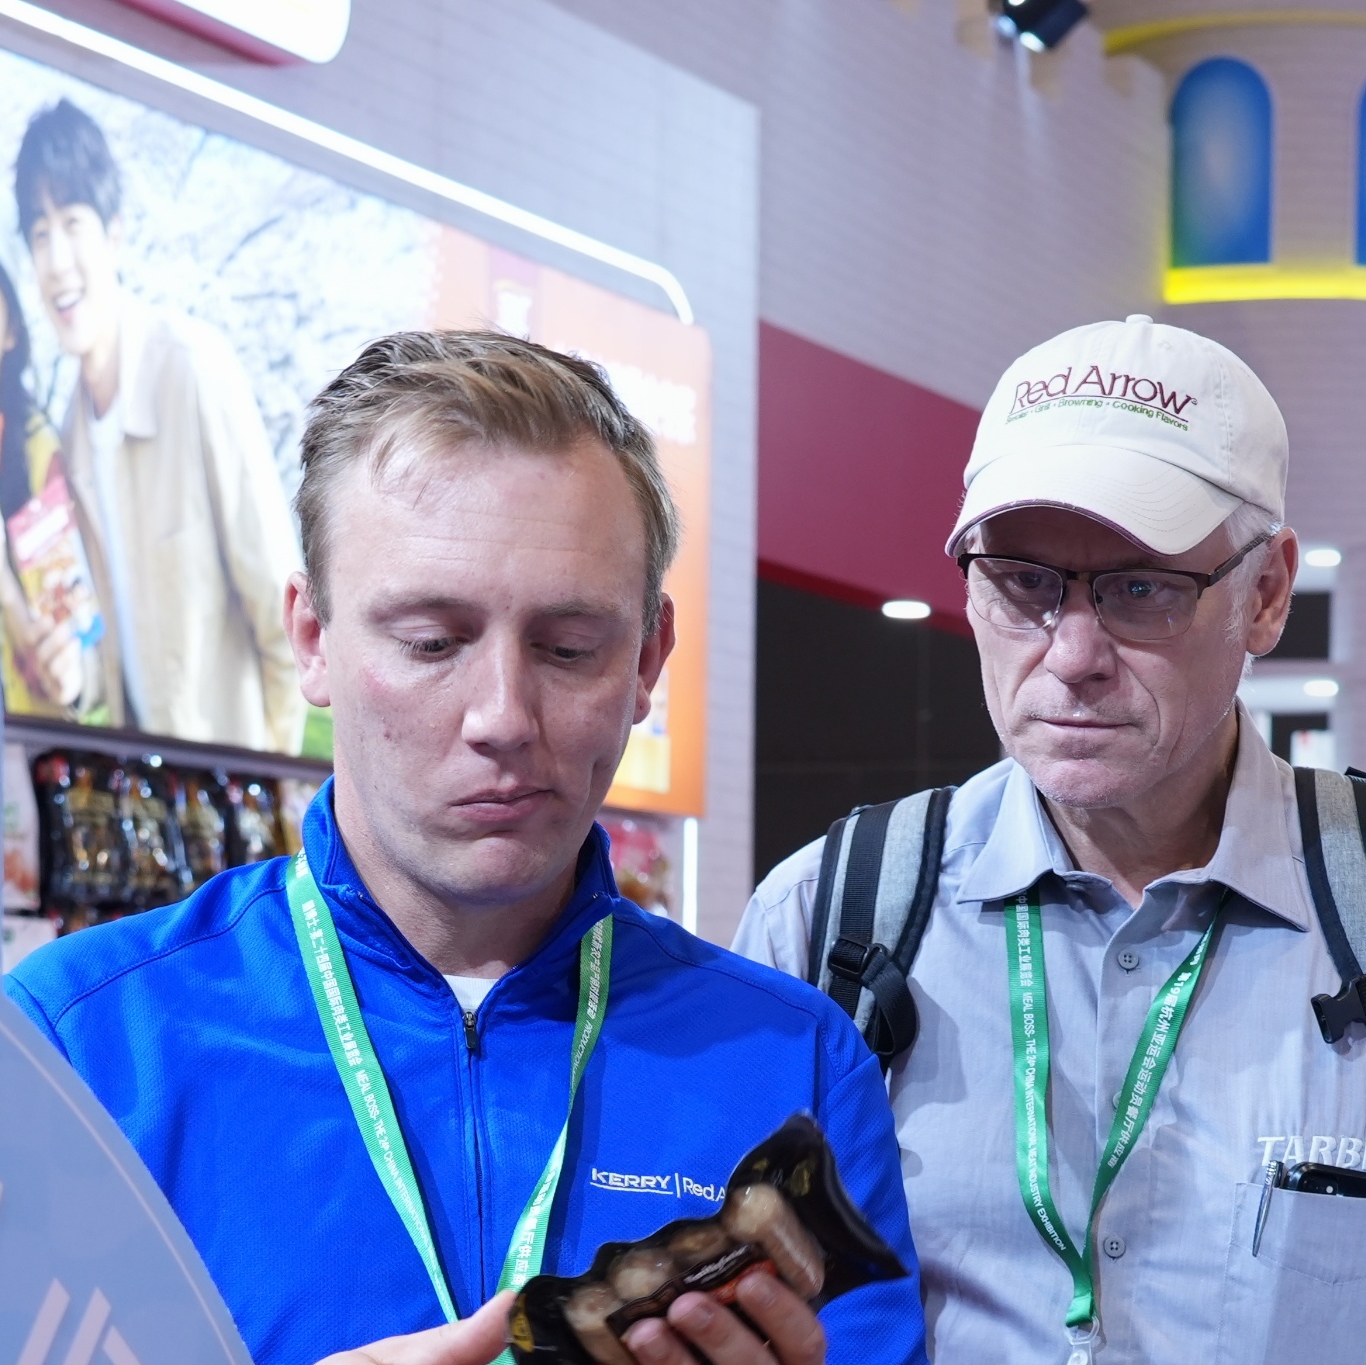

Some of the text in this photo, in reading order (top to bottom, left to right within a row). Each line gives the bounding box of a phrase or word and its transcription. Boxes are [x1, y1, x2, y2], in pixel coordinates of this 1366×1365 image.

[1009, 366, 1072, 414] Red
[1112, 400, 1154, 418] Cooking
[1156, 410, 1188, 432] Flavors
[1017, 892, 1033, 986] 中国国际肉类工业展览会
[373, 1119, 386, 1138] THE
[1025, 1039, 1035, 1054] THE
[1036, 1207, 1066, 1250] EXHIBITION
[591, 1168, 671, 1189] KERRY
[683, 1177, 715, 1200] Red
